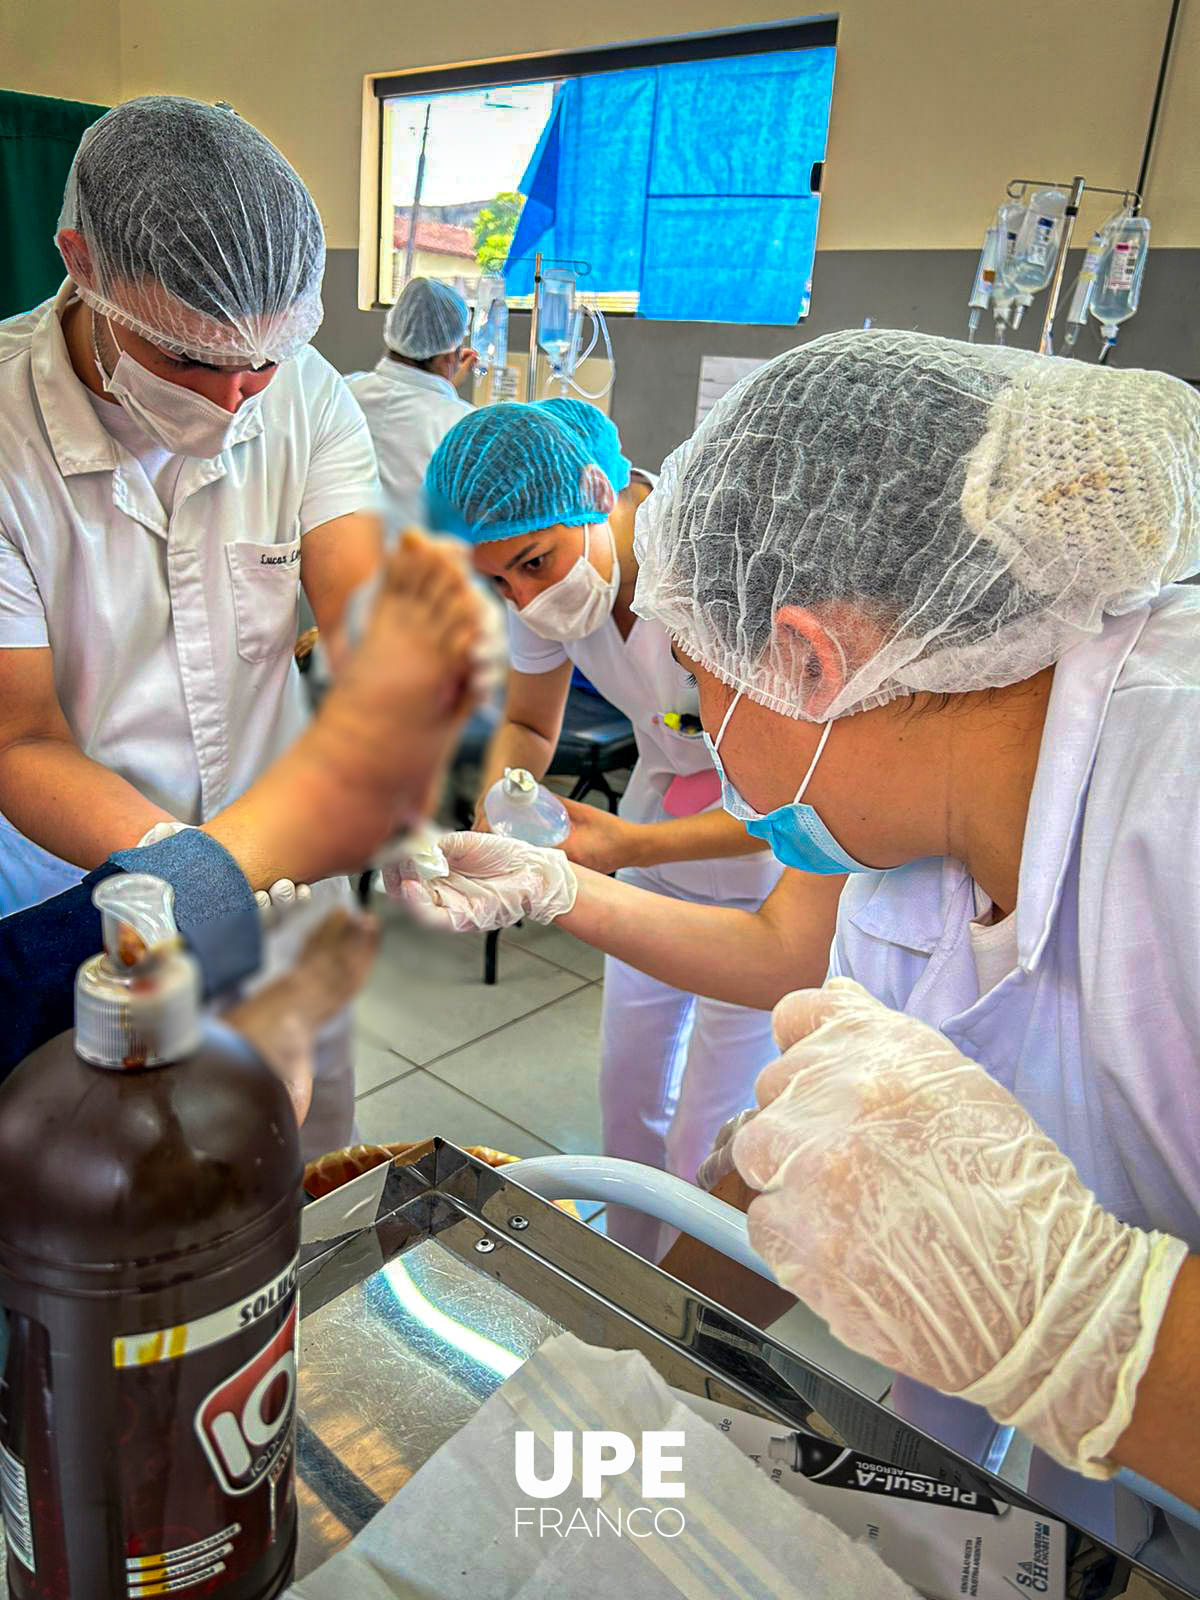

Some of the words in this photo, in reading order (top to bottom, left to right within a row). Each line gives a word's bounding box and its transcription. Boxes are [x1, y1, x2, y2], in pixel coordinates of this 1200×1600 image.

[260, 554, 287, 565] Lucas
[719, 1417, 733, 1433] de
[855, 1460, 905, 1477] AEROSOL
[855, 1469, 978, 1506] Platsul-A
